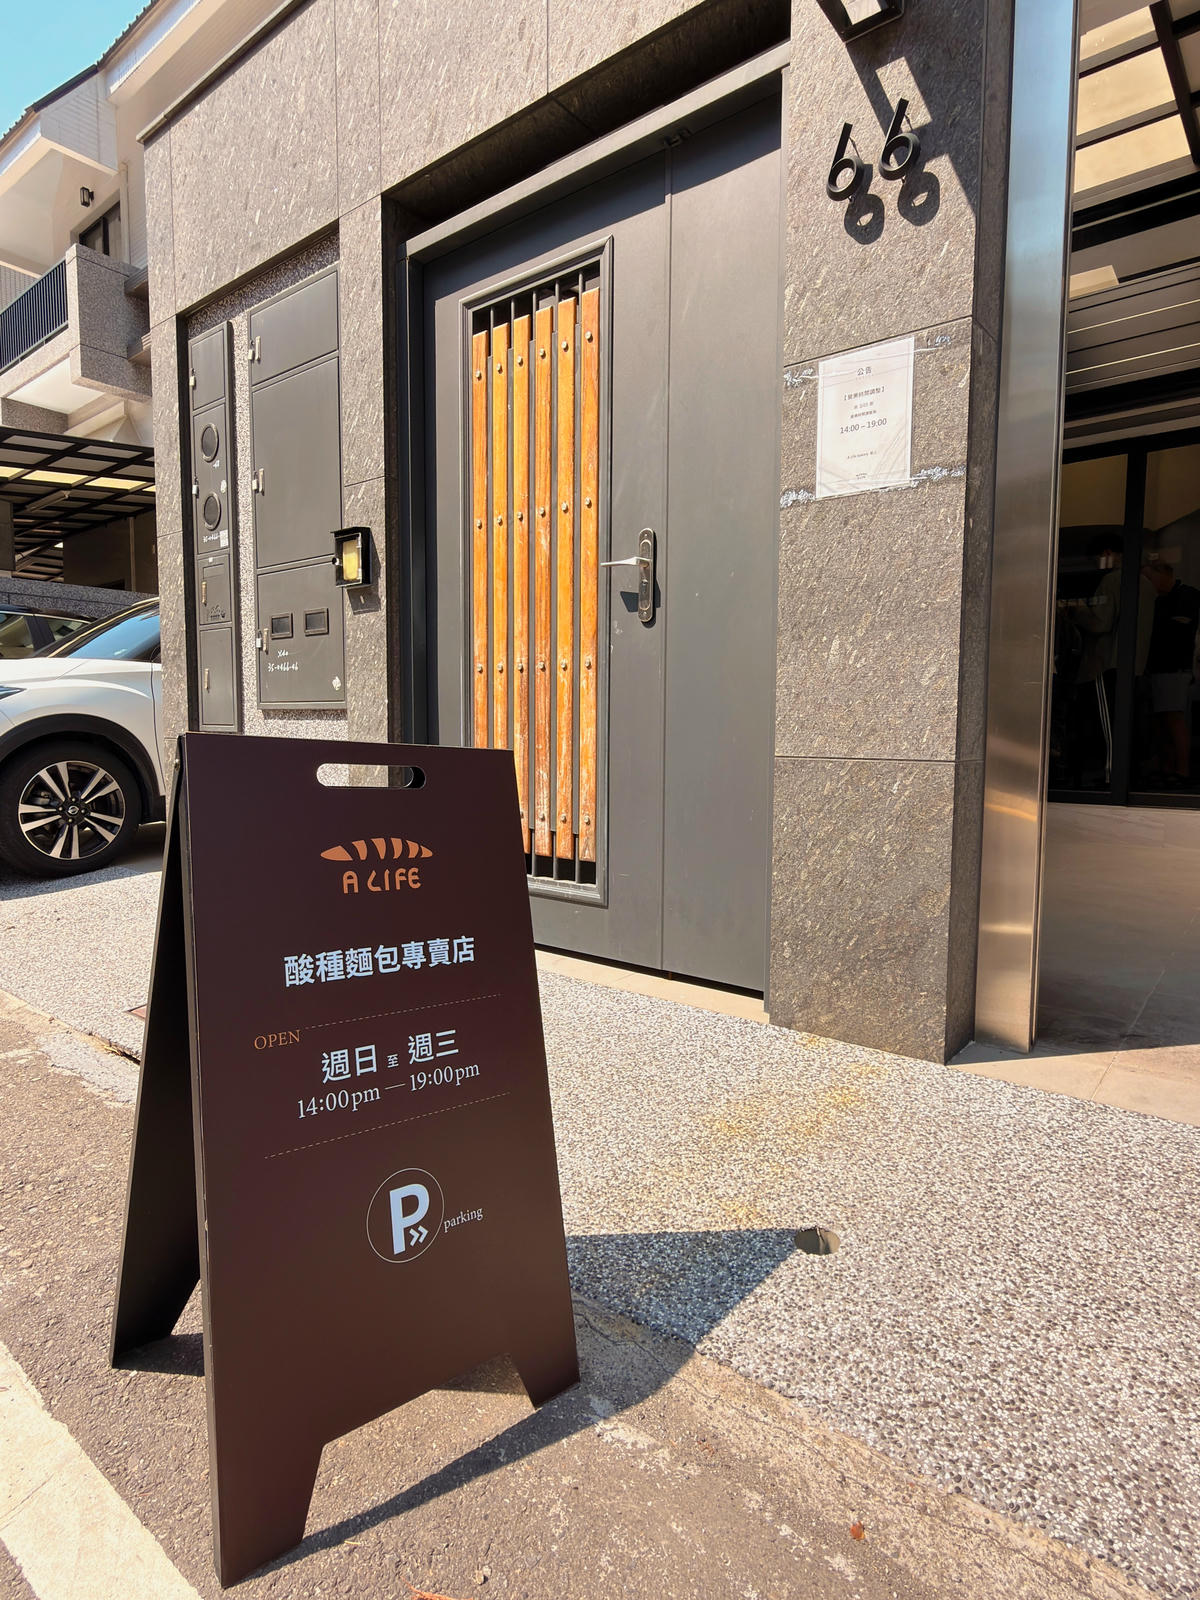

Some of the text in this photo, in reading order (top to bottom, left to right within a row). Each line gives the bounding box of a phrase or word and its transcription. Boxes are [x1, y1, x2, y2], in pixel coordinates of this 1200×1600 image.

[826, 98, 922, 202] 66
[857, 366, 872, 376] 公告
[840, 423, 860, 434] 14:00
[867, 418, 888, 429] 19:00
[342, 867, 422, 894] A LIFE
[283, 935, 475, 987] 酸種麵包專賣店
[254, 1029, 301, 1050] OPEN
[321, 1029, 459, 1084] 週日 至 週三
[297, 1087, 381, 1119] 14:00pm
[409, 1063, 480, 1091] 19:00pm
[389, 1183, 484, 1255] P parking
